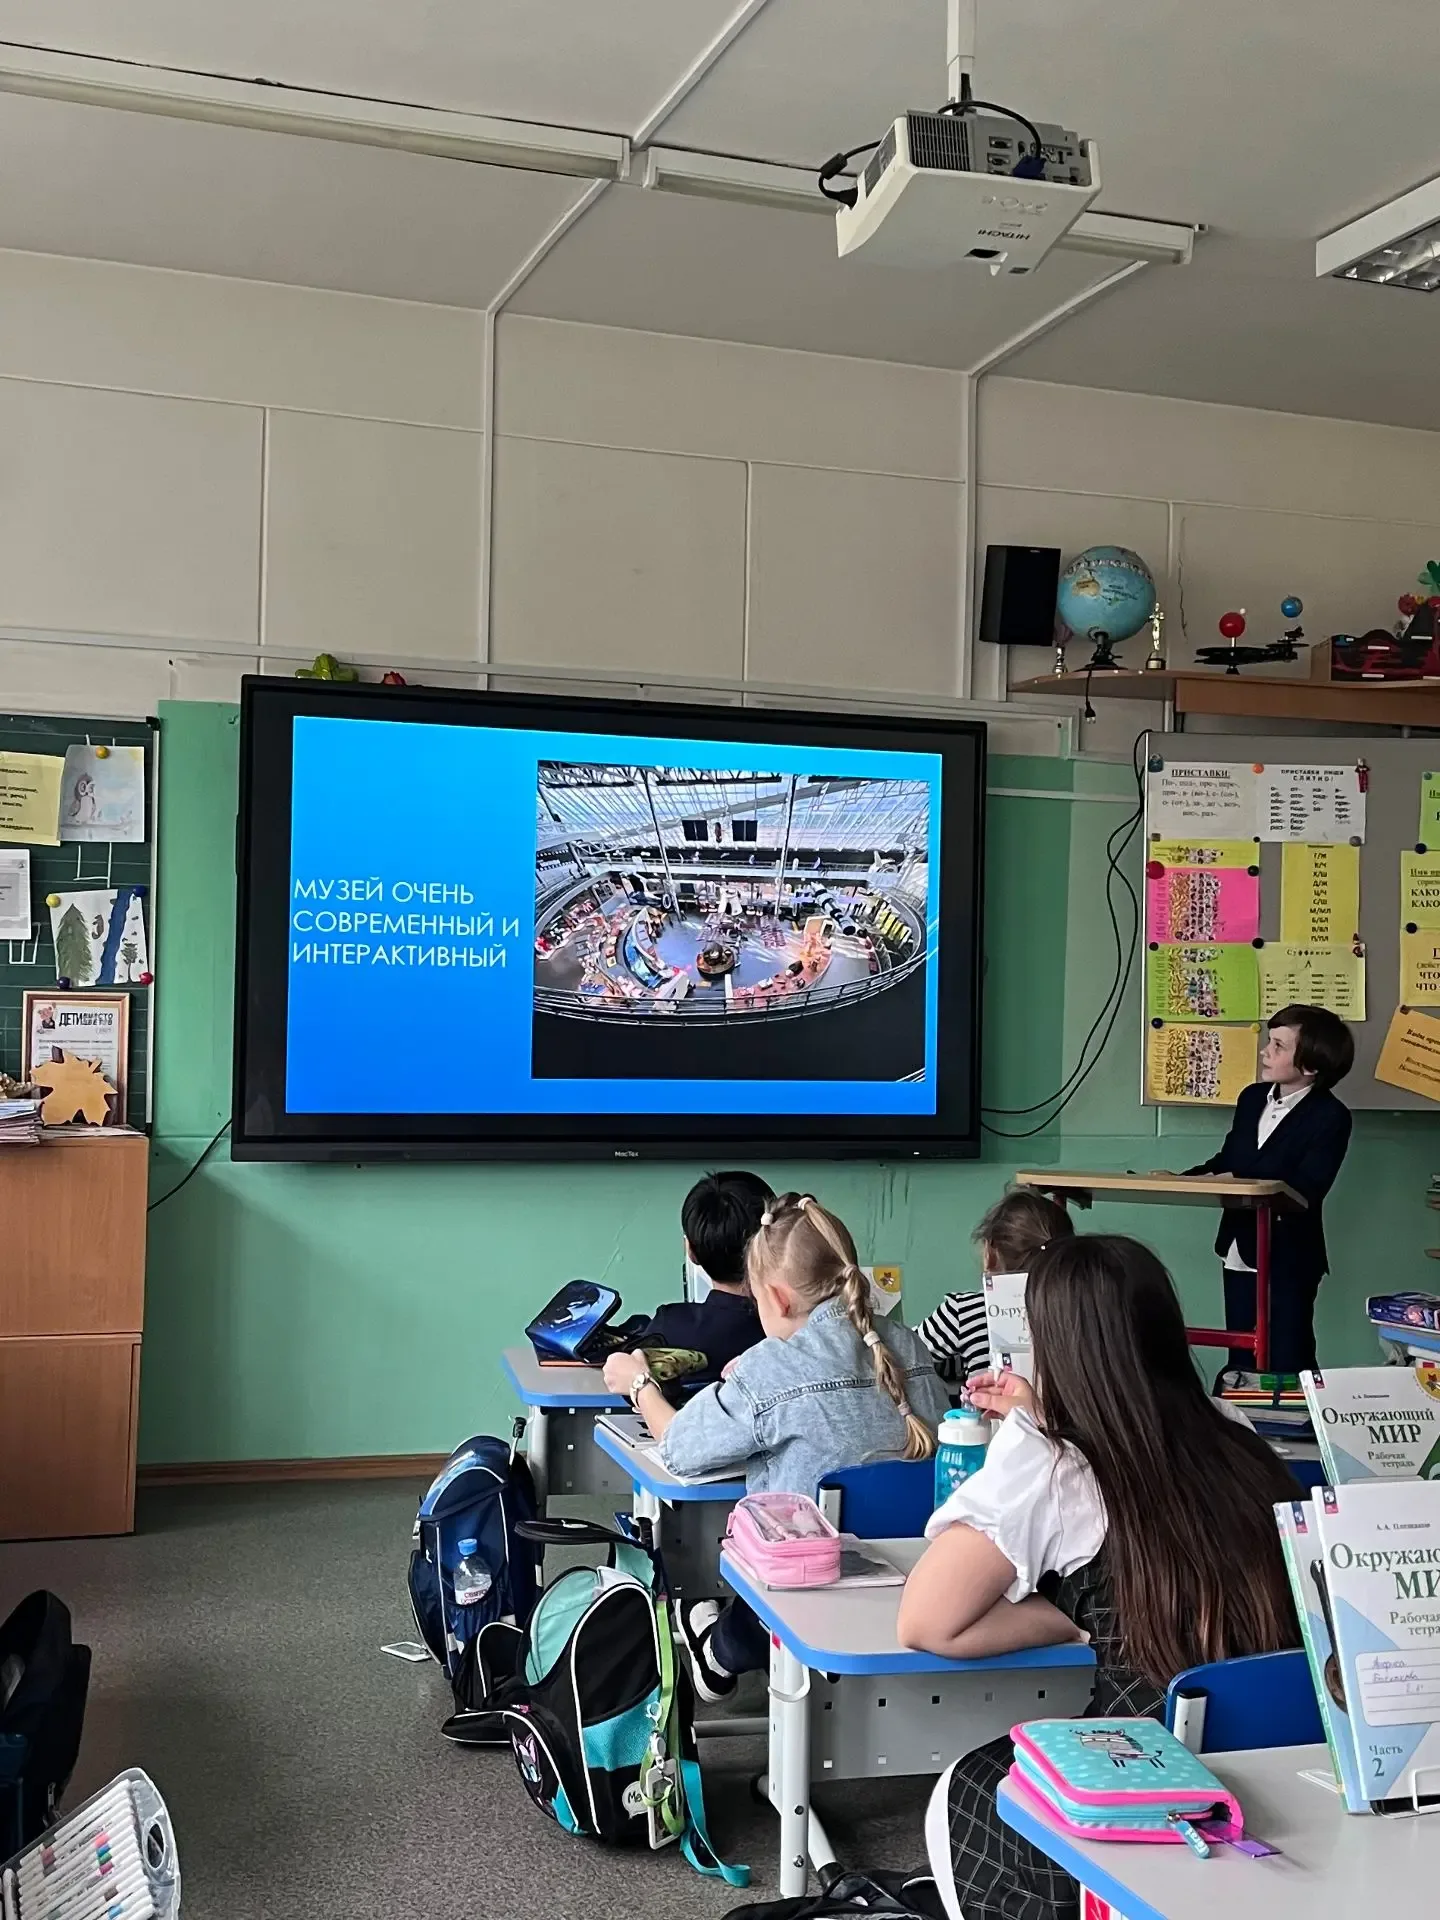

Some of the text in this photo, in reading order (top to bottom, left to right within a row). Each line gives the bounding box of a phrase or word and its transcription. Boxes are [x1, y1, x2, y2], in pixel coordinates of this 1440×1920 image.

[978, 229, 1030, 240] HITACHI
[294, 876, 474, 905] МУЗЕЙ ОЧЕНЬ
[293, 910, 520, 937] СОВРЕМЕННЫЙ И
[292, 941, 507, 968] ИНТЕРАКТИВНЫЙ
[59, 1012, 83, 1027] ДЕТИ
[988, 1304, 1026, 1319] Окру
[1321, 1407, 1435, 1426] Окружающий
[1367, 1424, 1422, 1444] МИР
[1368, 1450, 1406, 1461] Рабочая
[1382, 1460, 1416, 1469] тетрадь
[1369, 1744, 1404, 1756] Часть
[1372, 1757, 1385, 1777] 2
